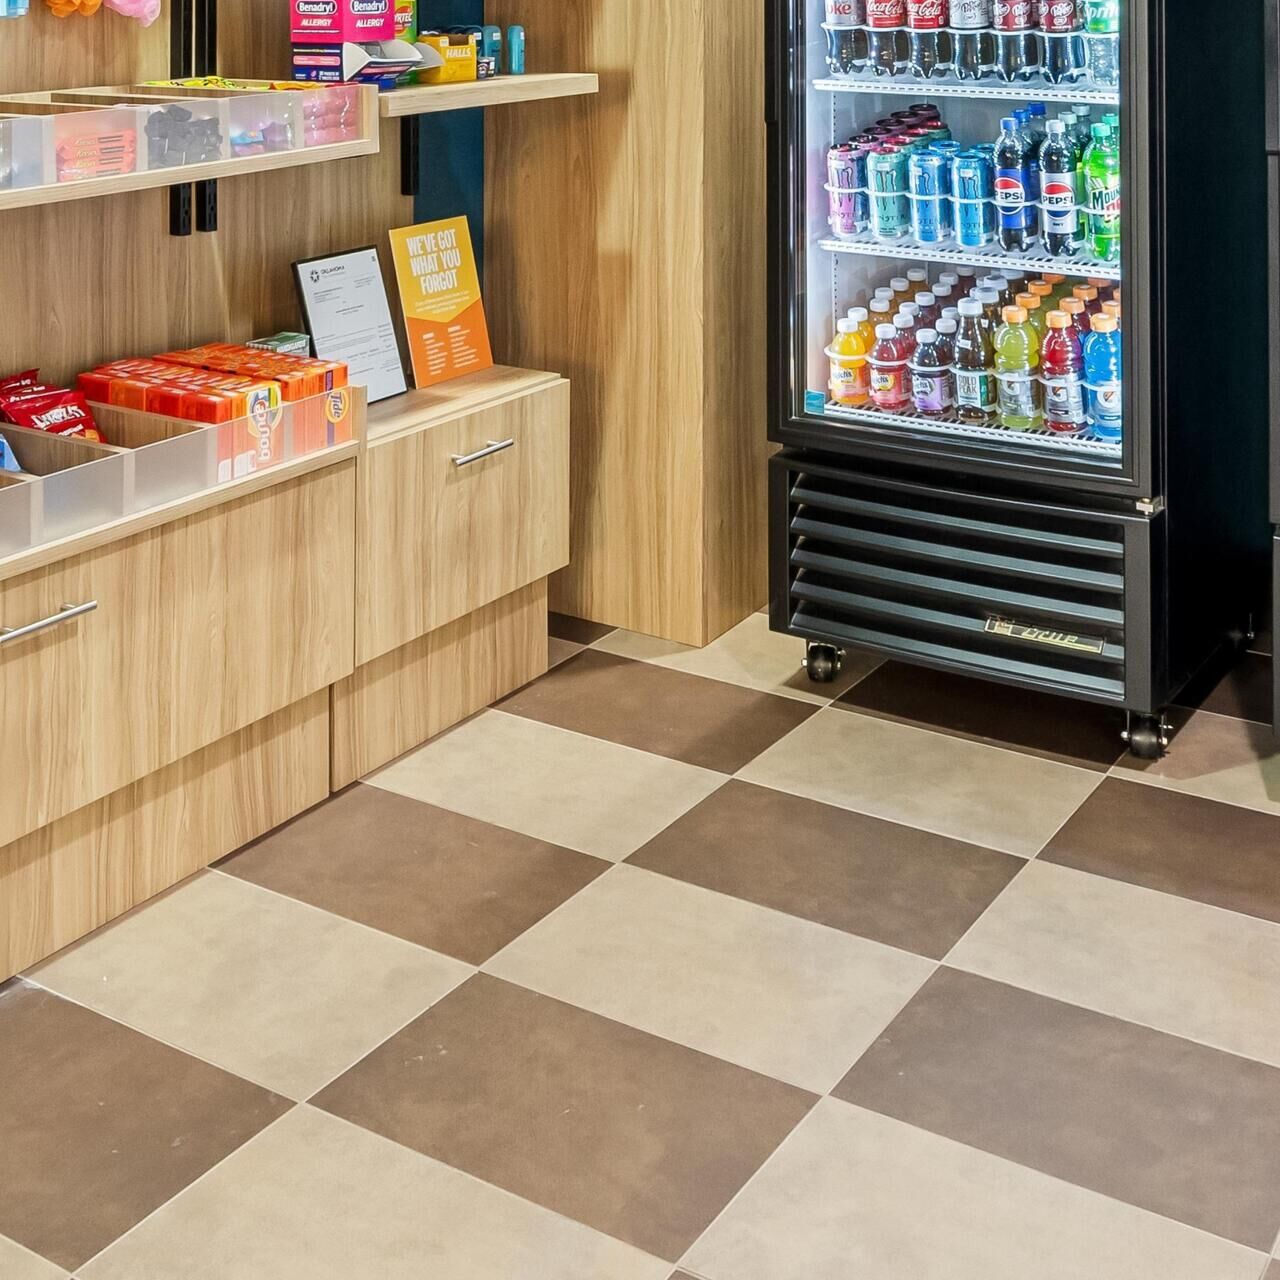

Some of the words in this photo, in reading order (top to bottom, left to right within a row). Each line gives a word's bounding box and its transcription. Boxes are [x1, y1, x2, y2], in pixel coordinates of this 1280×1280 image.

[299, 1, 333, 14] Benadryl
[353, 0, 385, 13] Benadryl
[301, 18, 333, 27] ALLERGY
[355, 18, 384, 28] ALLERGY
[446, 47, 471, 58] HALLS
[1042, 195, 1073, 206] PEPSI
[406, 233, 436, 257] WE'VE
[438, 229, 457, 250] GOT
[410, 253, 440, 277] WHAT
[441, 248, 461, 270] YOU
[420, 269, 458, 295] FORGOT
[958, 375, 977, 385] COLD
[959, 385, 977, 394] PEAK
[332, 391, 343, 418] Tide
[256, 399, 271, 461] bounce
